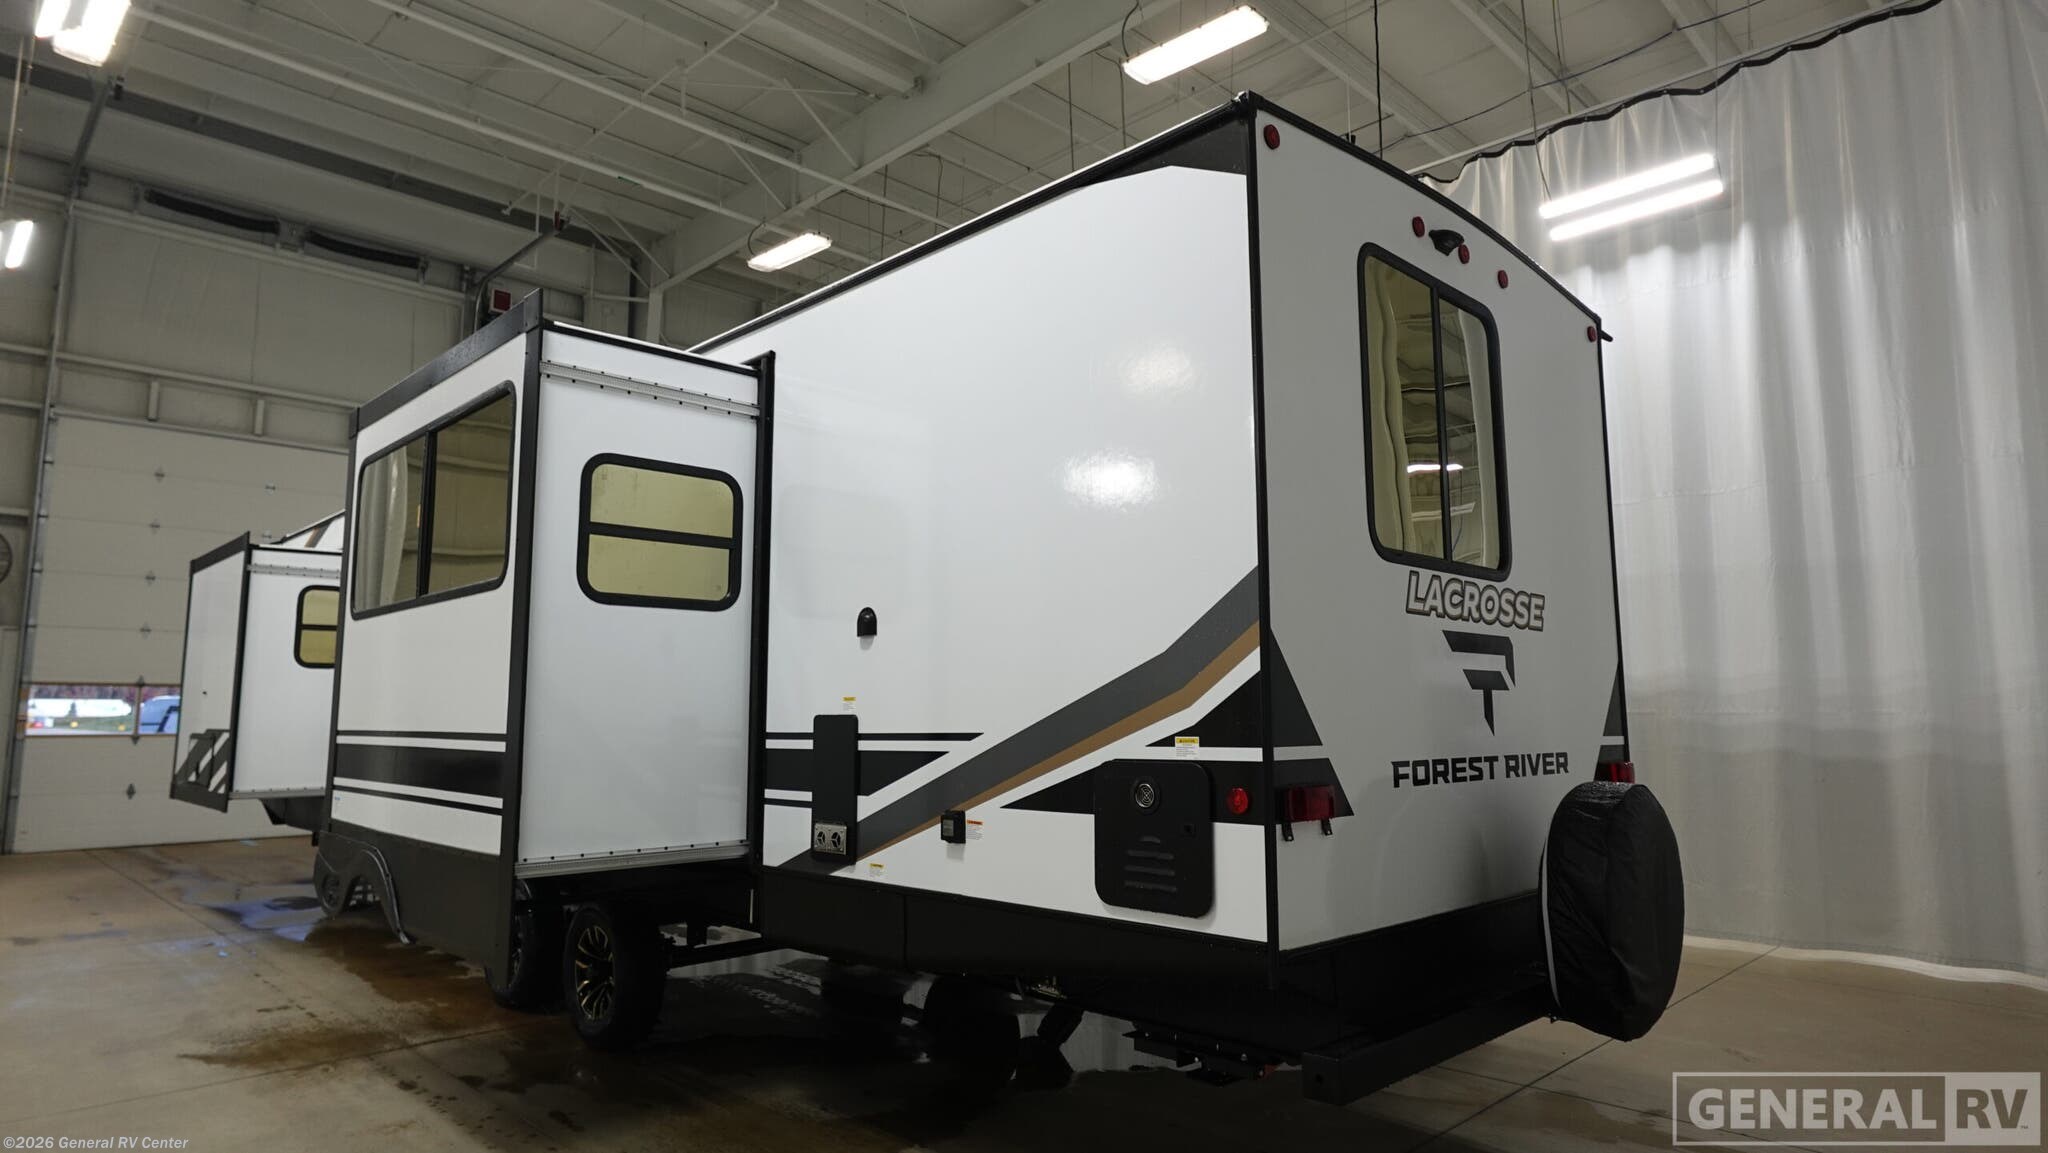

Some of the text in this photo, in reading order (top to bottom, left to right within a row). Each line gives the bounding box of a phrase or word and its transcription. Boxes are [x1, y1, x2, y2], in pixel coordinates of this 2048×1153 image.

[1406, 570, 1545, 631] LACROSSE
[1391, 752, 1569, 788] FOREST RIVER
